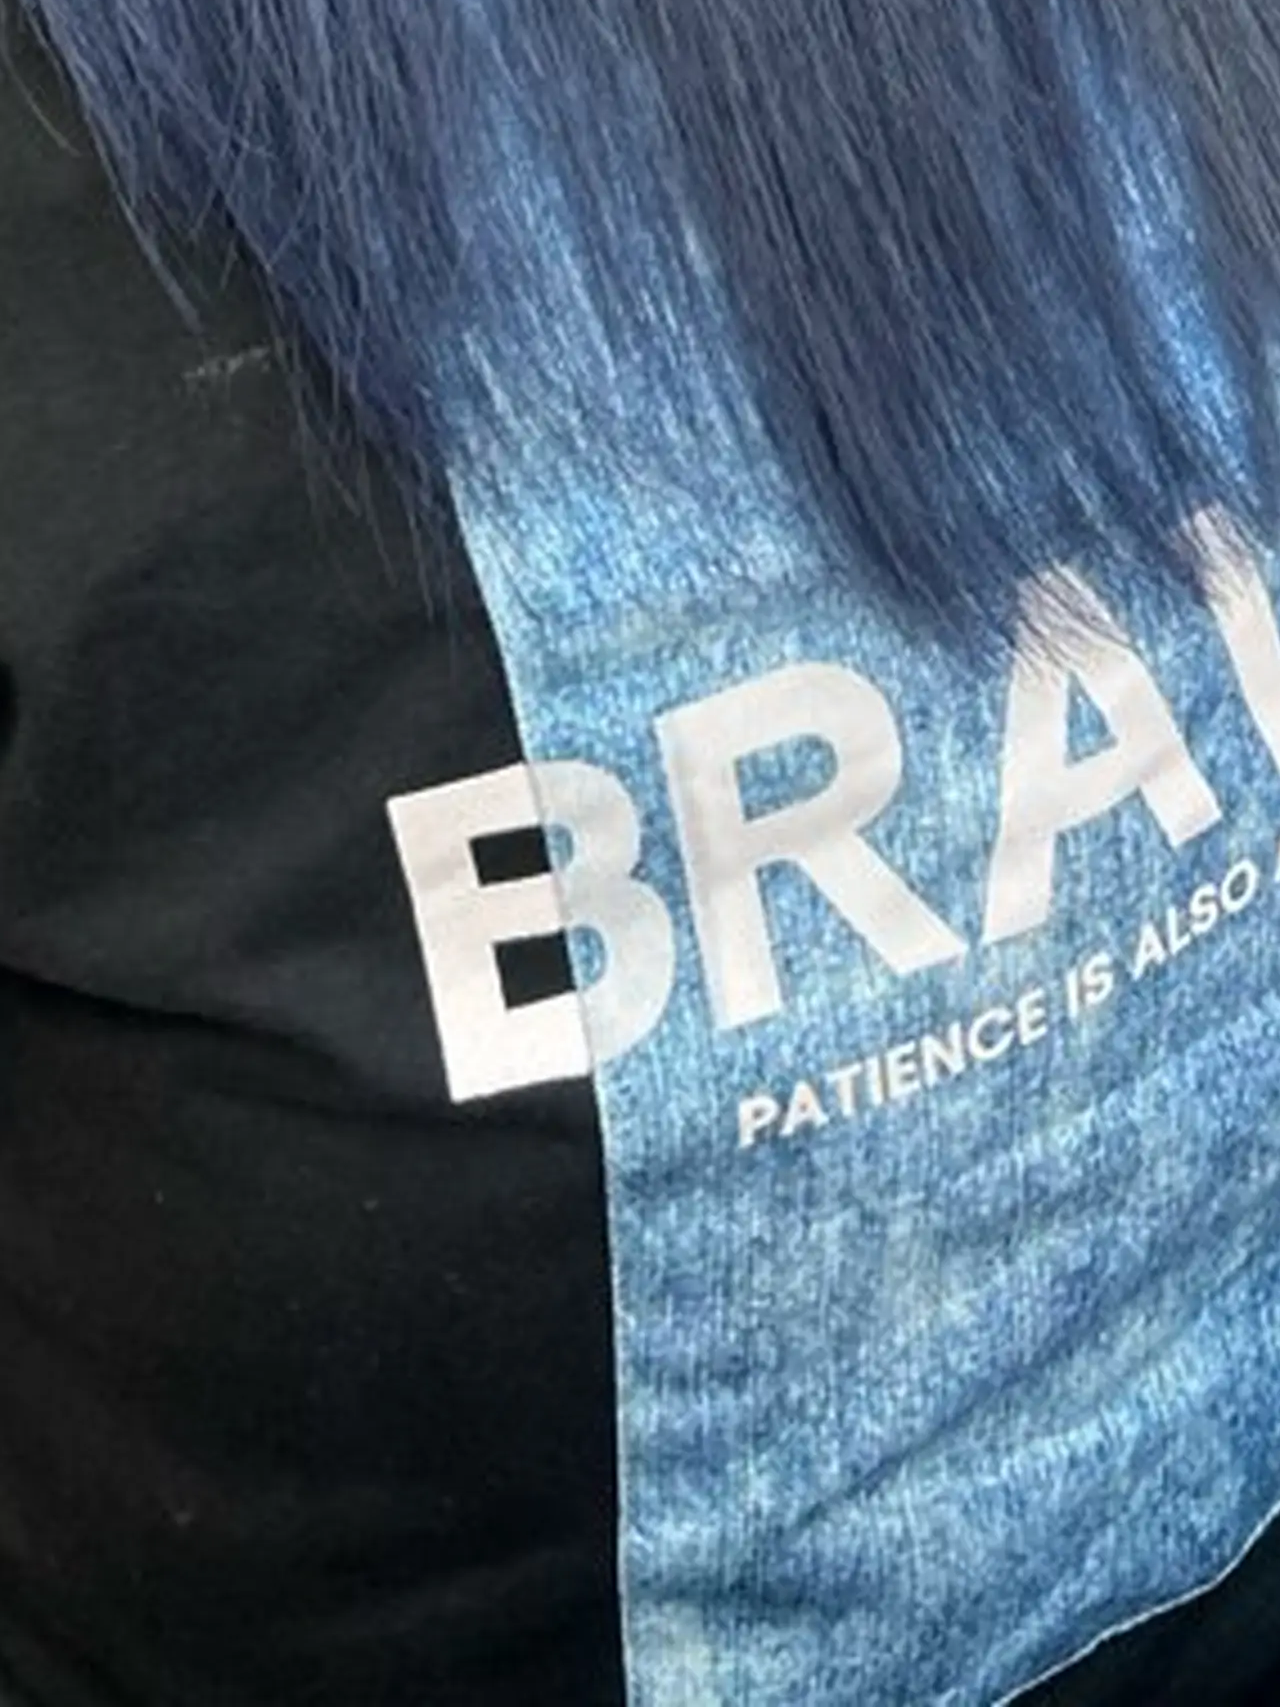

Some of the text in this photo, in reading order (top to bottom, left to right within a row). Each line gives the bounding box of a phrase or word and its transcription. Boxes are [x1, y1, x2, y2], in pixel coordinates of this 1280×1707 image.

[738, 988, 1048, 1149] PATIENCE
[1067, 951, 1115, 1018] IS
[1131, 859, 1259, 981] ALSO
